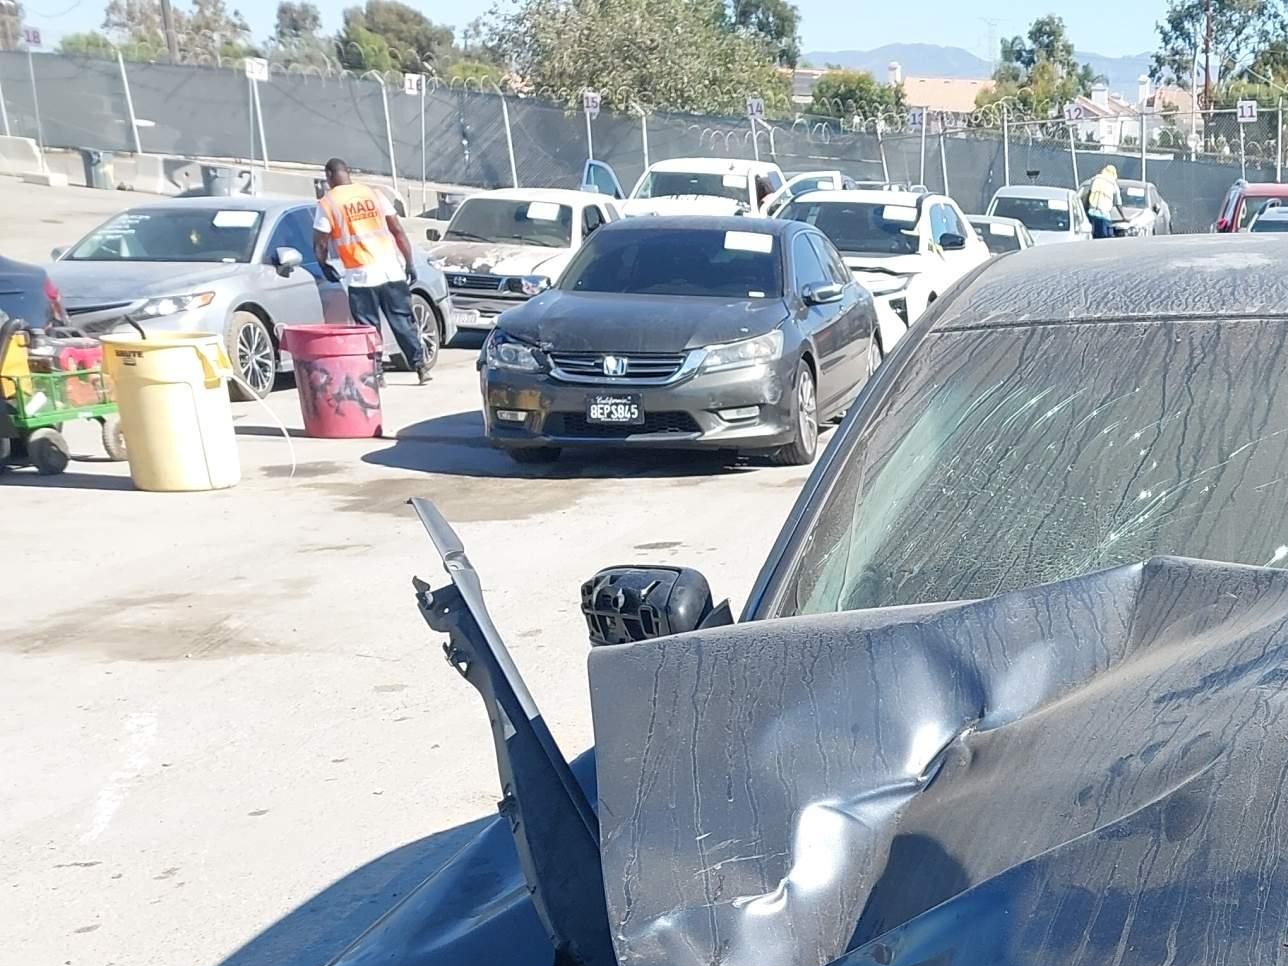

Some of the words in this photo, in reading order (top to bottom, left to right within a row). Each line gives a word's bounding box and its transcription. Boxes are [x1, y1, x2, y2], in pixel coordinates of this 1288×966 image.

[24, 30, 41, 44] 18
[249, 62, 262, 74] 17
[585, 95, 599, 109] 15
[748, 101, 763, 115] 14
[1066, 108, 1083, 121] 12
[1239, 105, 1256, 118] 11
[343, 199, 376, 217] MAD
[590, 404, 638, 418] 8EPS845
